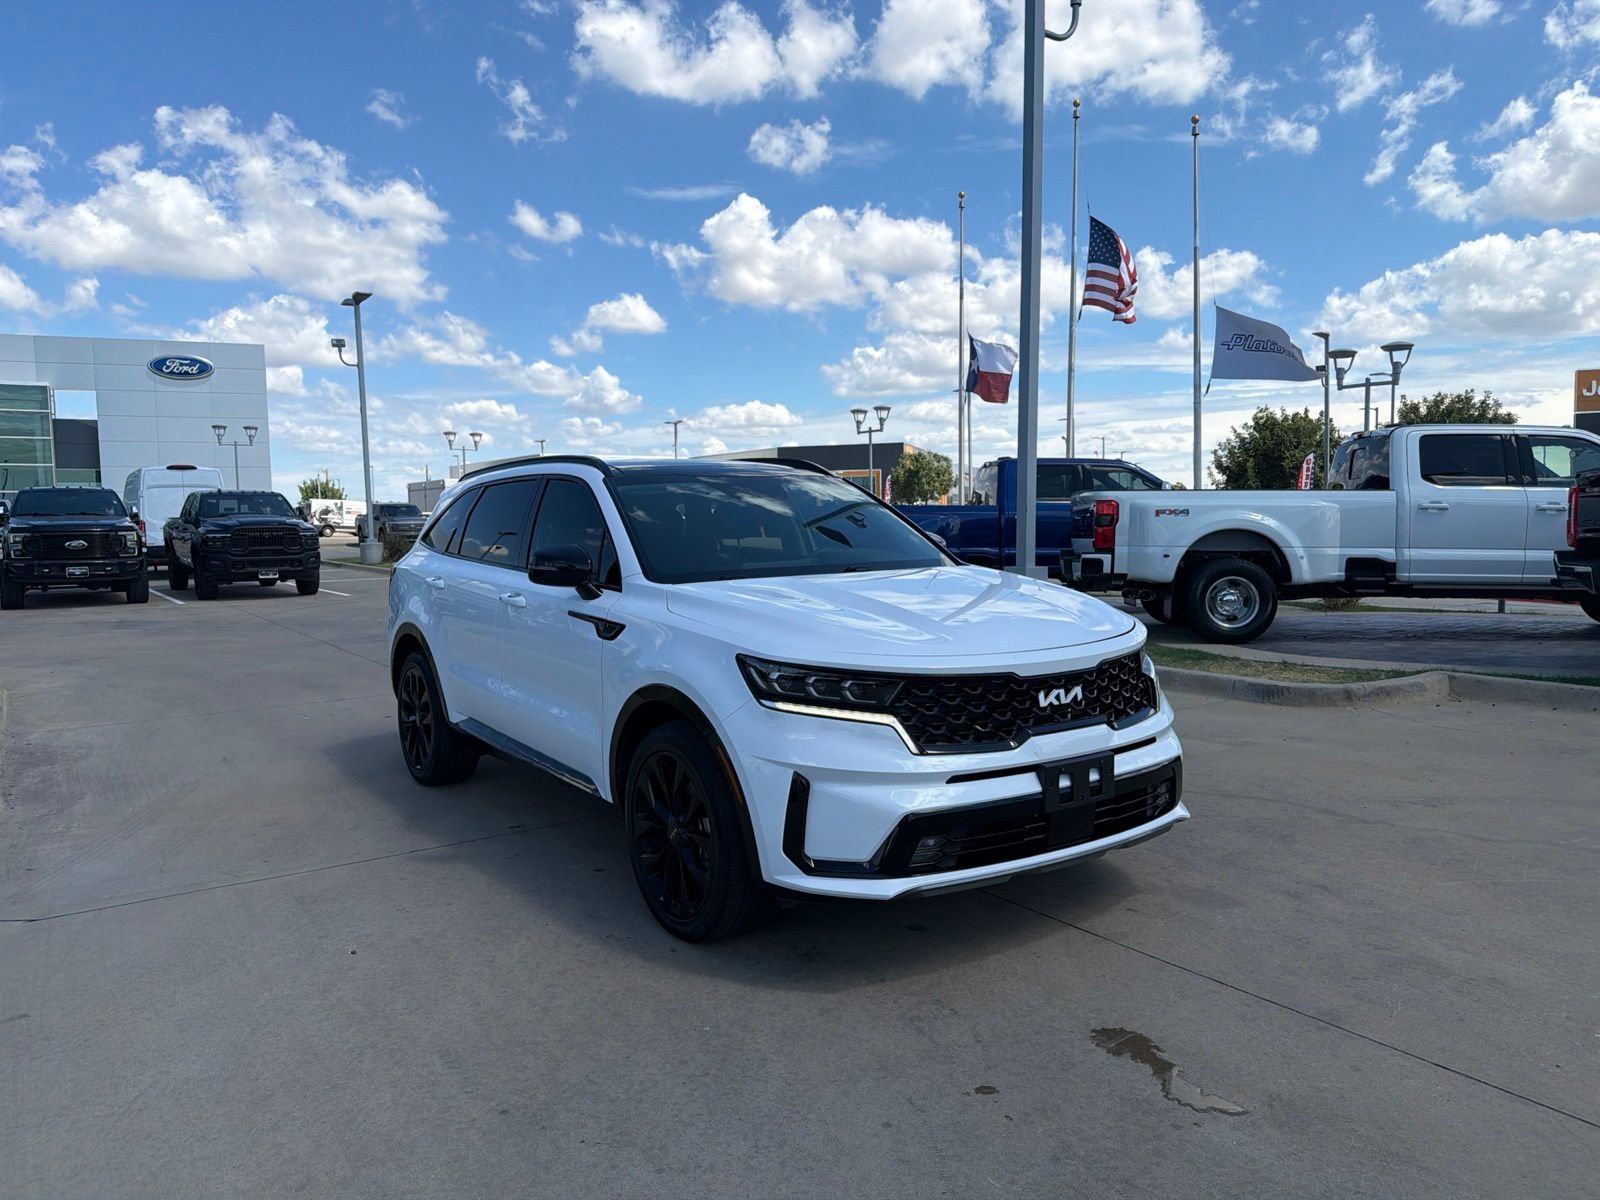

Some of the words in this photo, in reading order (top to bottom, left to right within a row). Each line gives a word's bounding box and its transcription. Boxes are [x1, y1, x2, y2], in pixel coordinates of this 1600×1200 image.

[162, 358, 200, 374] Ford
[1154, 508, 1190, 518] FX4
[1038, 684, 1083, 708] KIA
